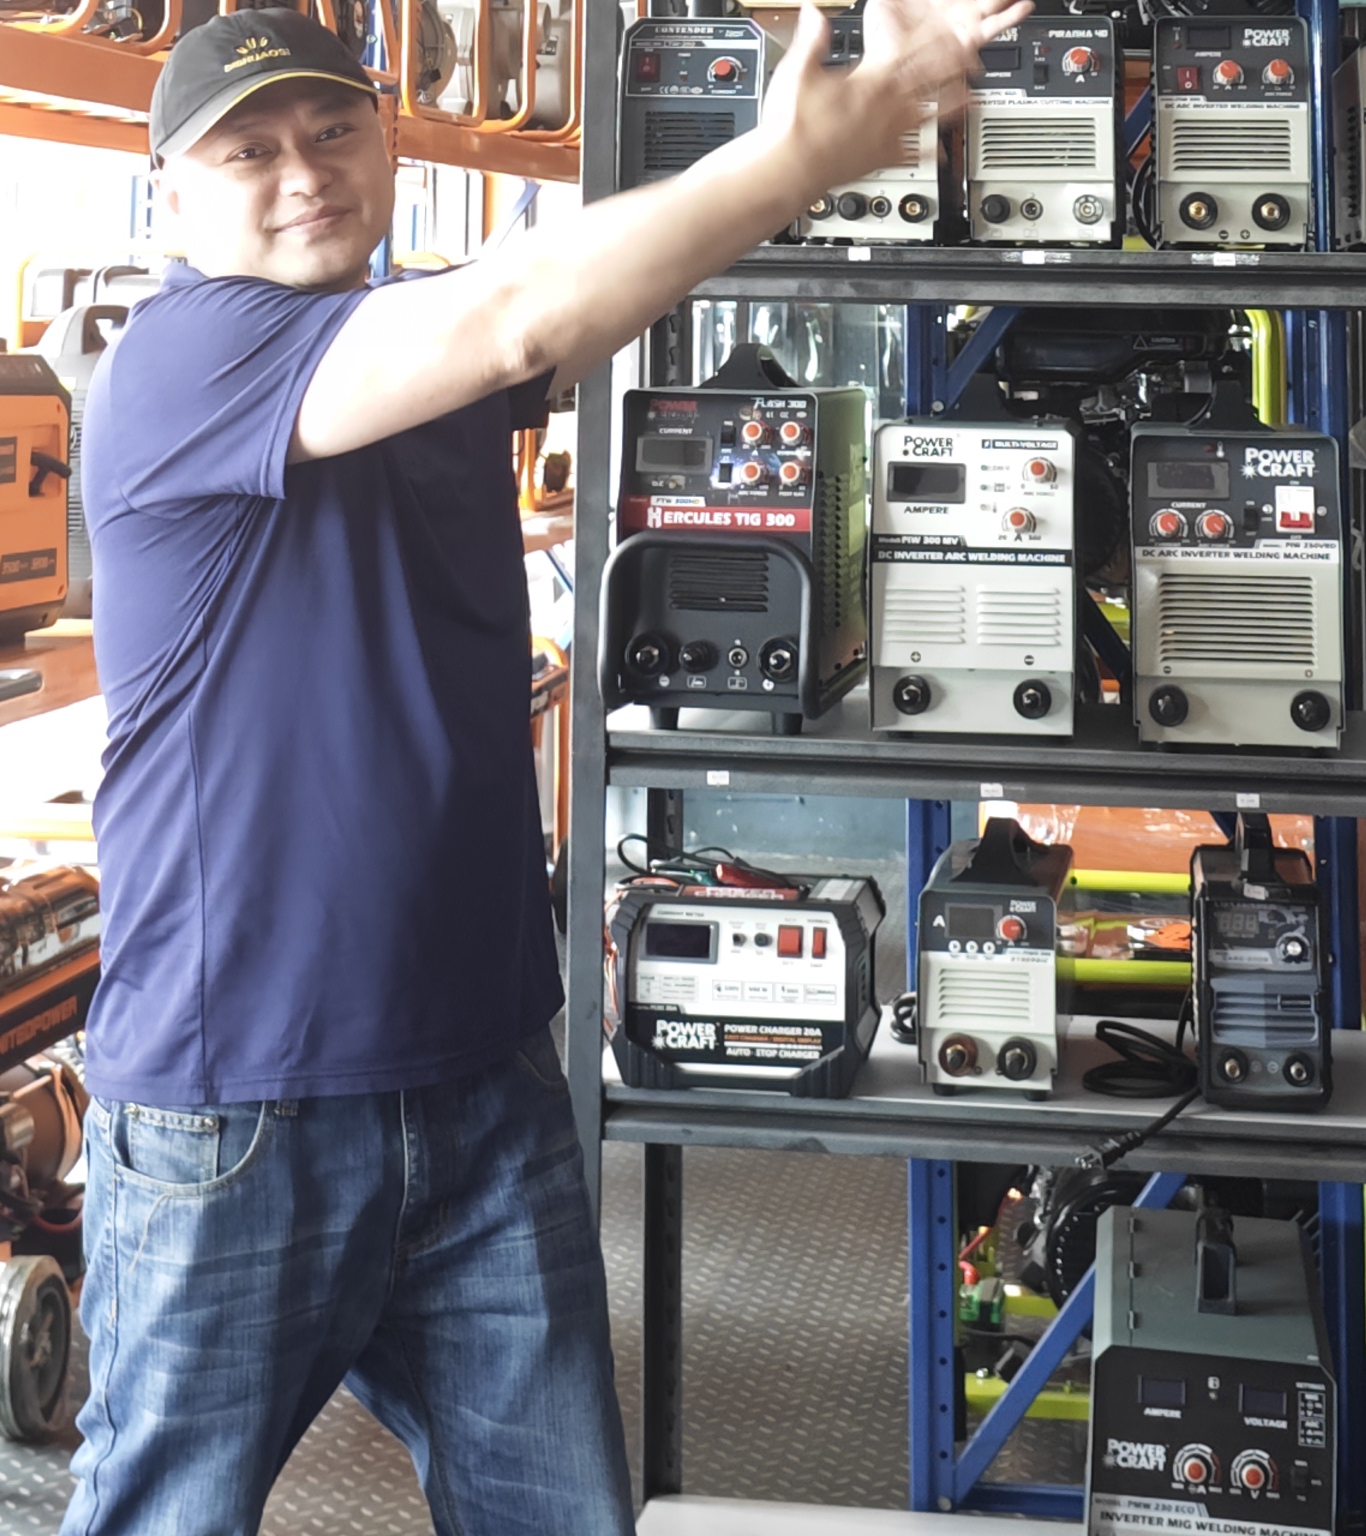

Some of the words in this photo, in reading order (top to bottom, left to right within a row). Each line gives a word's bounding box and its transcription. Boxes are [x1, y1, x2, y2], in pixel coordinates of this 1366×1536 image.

[1049, 30, 1093, 38] PIRANHA
[1244, 28, 1289, 39] POWER
[1252, 37, 1290, 46] CRAFT
[1075, 74, 1085, 82] A
[904, 435, 953, 448] POWER
[912, 446, 953, 456] CRAFT
[1245, 448, 1314, 464] POWER
[1257, 463, 1315, 478] CRAFT
[647, 507, 731, 528] HERCULES
[735, 513, 761, 526] TIG
[766, 514, 795, 527] 300
[1014, 533, 1022, 542] A
[878, 552, 892, 560] DC
[894, 551, 943, 561] INVERTER
[945, 552, 966, 561] ARC
[968, 553, 1016, 562] WELDING
[1017, 554, 1065, 562] MACHINE
[933, 915, 945, 927] A
[656, 1020, 716, 1038] POWER
[724, 1025, 757, 1034] POWER
[760, 1026, 802, 1035] CHARGER
[804, 1027, 822, 1036] 20A
[666, 1034, 716, 1049] CRAFT
[726, 1048, 750, 1056] AUTO
[756, 1048, 777, 1057] STOP
[779, 1049, 820, 1059] CHARGER
[1144, 1407, 1181, 1418] AMPERE
[1244, 1416, 1288, 1429] VOLTAGE
[1107, 1438, 1166, 1456] POWER
[1116, 1453, 1166, 1471] CRAFT
[1175, 1504, 1195, 1514] ECO
[1101, 1511, 1164, 1526] INVERTER
[1167, 1516, 1191, 1529] MIG
[1194, 1520, 1256, 1535] WELDING
[1259, 1523, 1321, 1536] MACHINE
